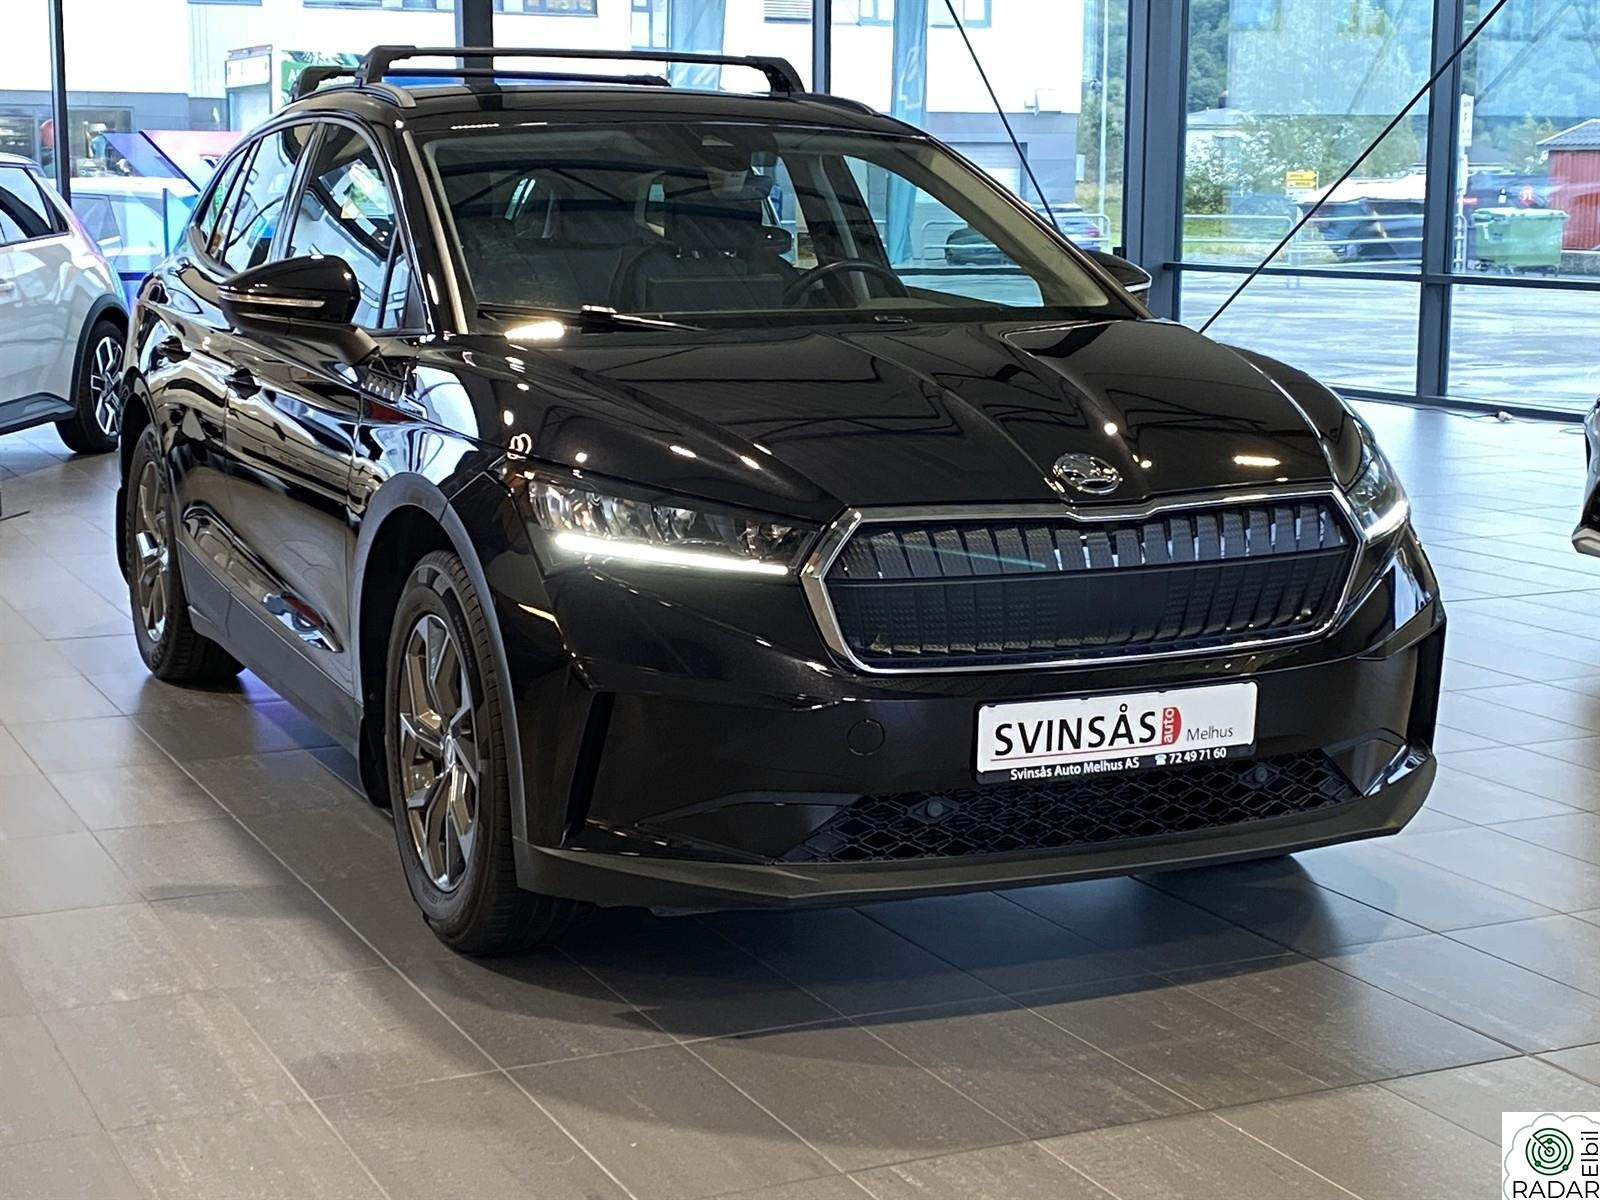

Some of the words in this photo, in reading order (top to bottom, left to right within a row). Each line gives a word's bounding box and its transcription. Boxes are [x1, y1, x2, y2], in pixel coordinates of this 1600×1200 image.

[994, 703, 1156, 756] SVINSÅS
[1162, 708, 1175, 744] auto
[1186, 725, 1234, 742] Melhus
[1169, 753, 1183, 764] 72
[1184, 751, 1198, 762] 49
[1200, 749, 1211, 760] 71
[1213, 747, 1227, 759] 60
[1010, 765, 1052, 781] Svinsås
[1054, 763, 1081, 777] Auto
[1083, 759, 1123, 774] Melhus
[1124, 757, 1140, 769] AS
